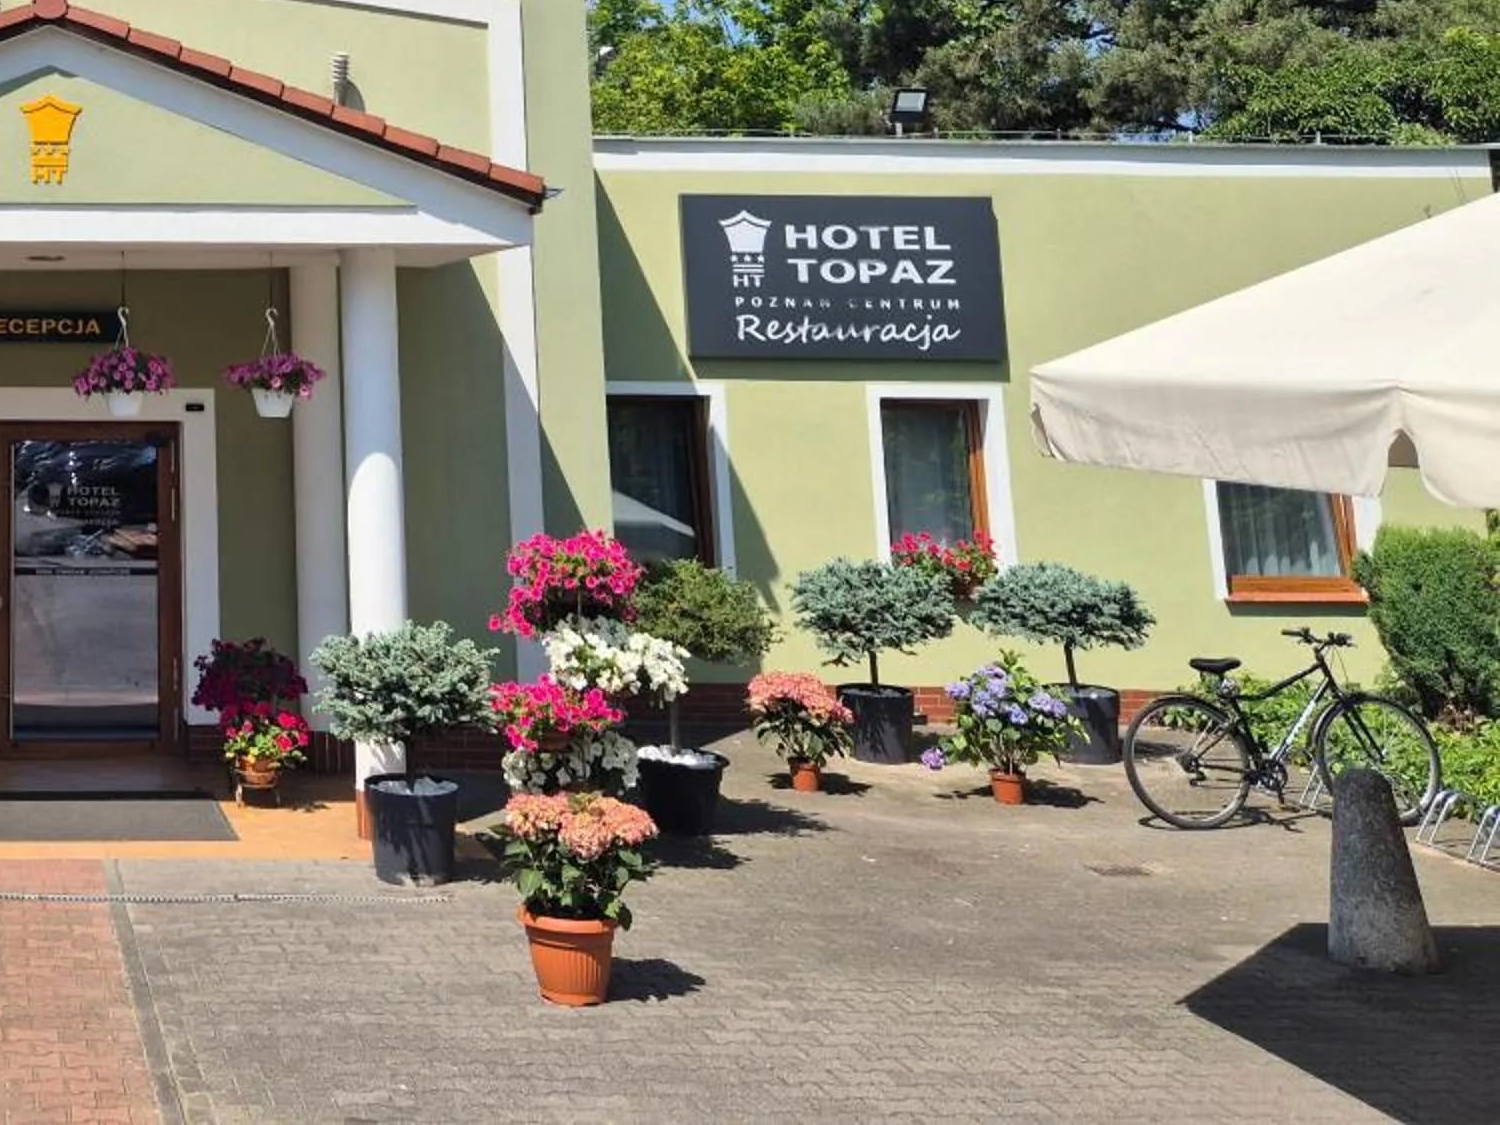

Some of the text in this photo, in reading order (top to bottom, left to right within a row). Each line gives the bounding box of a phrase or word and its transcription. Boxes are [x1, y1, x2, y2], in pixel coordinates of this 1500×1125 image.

[784, 224, 952, 251] HOTEL
[787, 258, 957, 285] TOPAZ
[732, 275, 765, 288] HT
[848, 298, 961, 310] CENTRUM
[735, 313, 961, 351] Restauracja
[67, 486, 120, 496] HOTEL
[67, 497, 120, 507] TOPAZ
